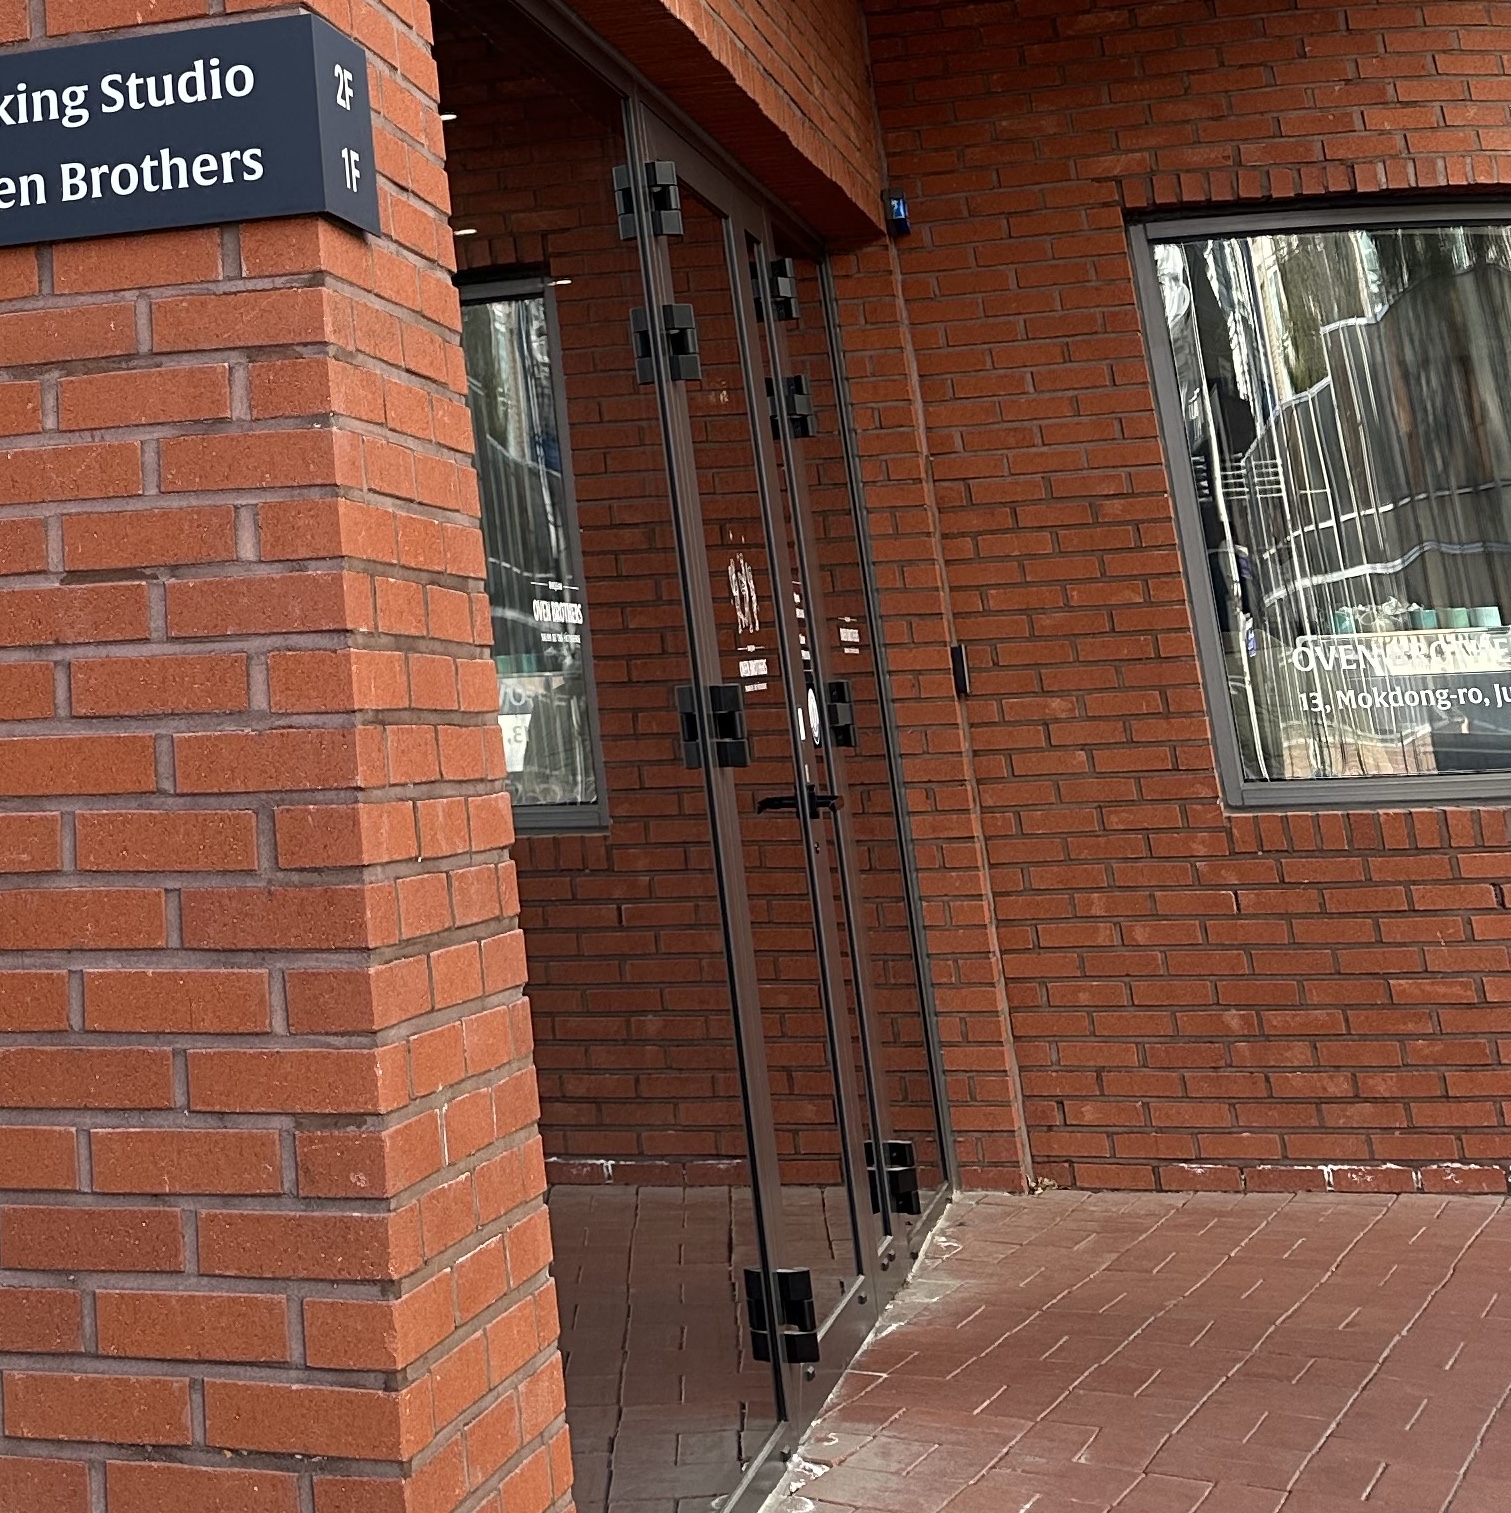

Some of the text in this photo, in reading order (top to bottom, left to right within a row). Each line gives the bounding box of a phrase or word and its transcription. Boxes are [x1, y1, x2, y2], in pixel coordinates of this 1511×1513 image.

[100, 57, 255, 114] Studio
[333, 64, 355, 111] 2F
[60, 147, 264, 202] Brothers
[341, 147, 361, 193] 1F
[1292, 642, 1385, 676] OVEN
[1299, 692, 1331, 713] 13,
[1336, 685, 1490, 711] Mokdong-ro,
